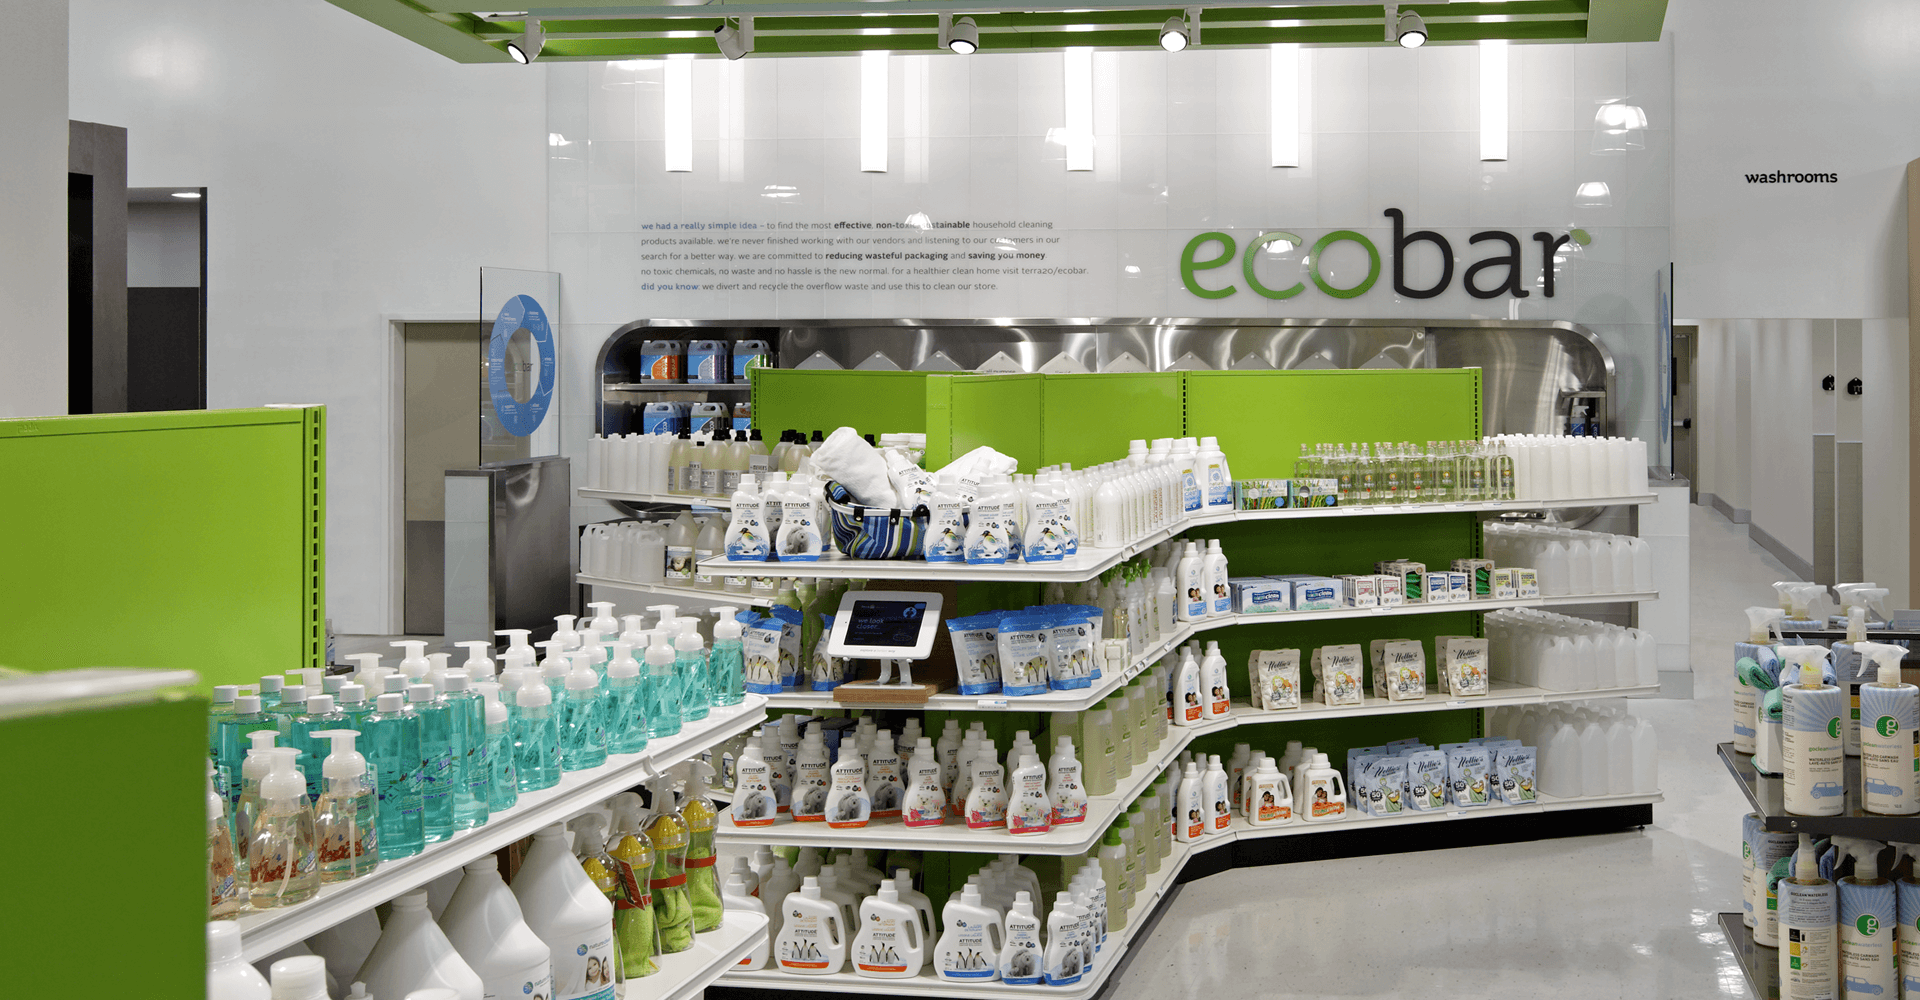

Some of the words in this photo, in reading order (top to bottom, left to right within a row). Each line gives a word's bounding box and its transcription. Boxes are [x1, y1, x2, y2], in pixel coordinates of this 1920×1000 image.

[1745, 170, 1838, 183] washrooms
[681, 222, 705, 230] really
[708, 222, 737, 230] simple
[1019, 221, 1053, 229] cleaning
[641, 238, 677, 246] products
[801, 237, 833, 246] working
[925, 237, 959, 245] listening
[669, 252, 682, 260] for
[767, 252, 813, 260] committed
[825, 252, 863, 261] reducing
[905, 252, 948, 261] packaging
[968, 252, 995, 260] saving
[1180, 207, 1571, 300] ecobar
[788, 267, 812, 275] hassle
[823, 267, 837, 275] the
[858, 267, 890, 275] normal.
[891, 267, 904, 275] for
[759, 283, 789, 291] recycle
[806, 282, 842, 290] overflow
[1394, 652, 1418, 663] Nellie's
[1456, 649, 1480, 660] Nellie's
[1264, 660, 1292, 672] Nellie's
[1330, 656, 1355, 667] Nellie's
[1417, 760, 1441, 773] Nellie's
[1457, 756, 1483, 769] Nellie's
